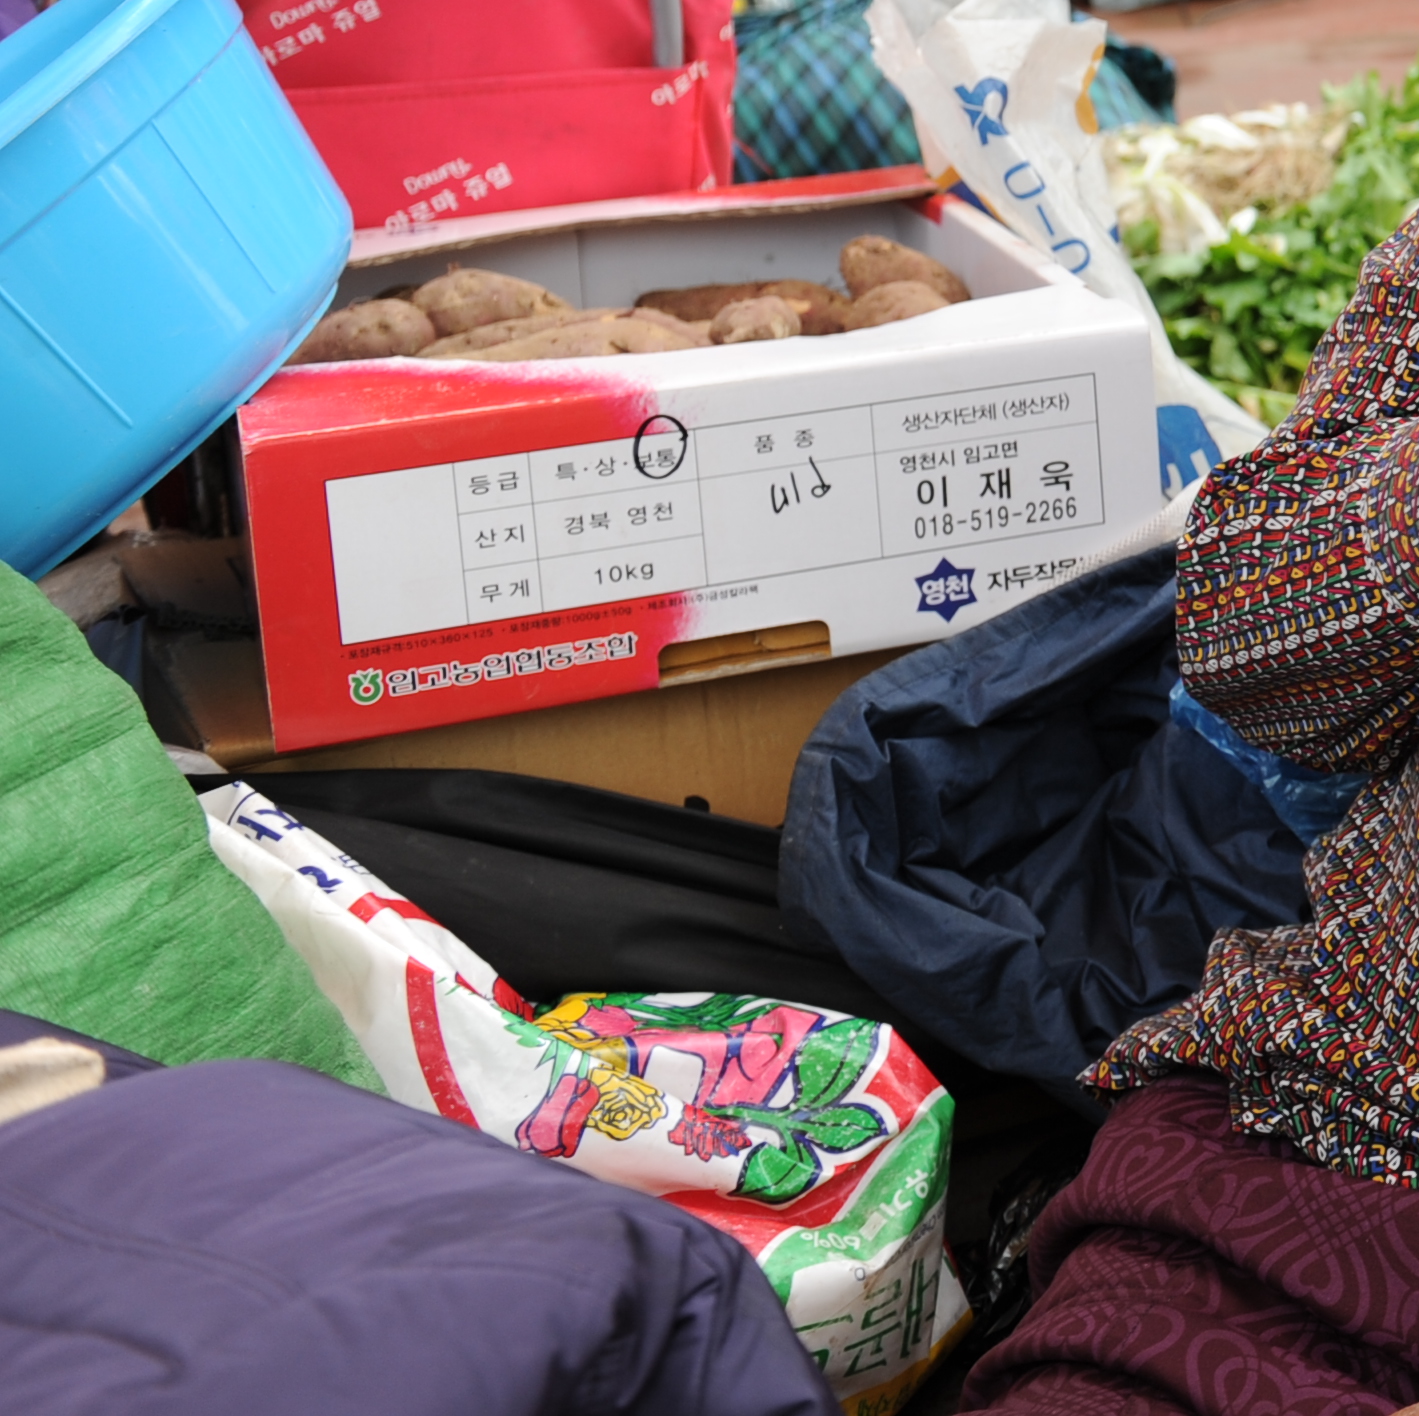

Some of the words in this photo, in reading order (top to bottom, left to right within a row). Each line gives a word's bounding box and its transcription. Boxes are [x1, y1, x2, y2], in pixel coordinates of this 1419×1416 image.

[901, 401, 997, 434] 생산자단체
[1001, 392, 1070, 421] (생산자)
[899, 448, 956, 475] 영천시
[962, 440, 1019, 465] 임고면
[563, 511, 611, 536] 경북
[626, 502, 674, 527] 영천
[914, 496, 1078, 540] 018-519-2266
[594, 562, 654, 586] 10kg
[920, 573, 971, 608] 영천
[385, 631, 639, 698] 임고농업협동조합
[858, 1167, 930, 1242] 유기
